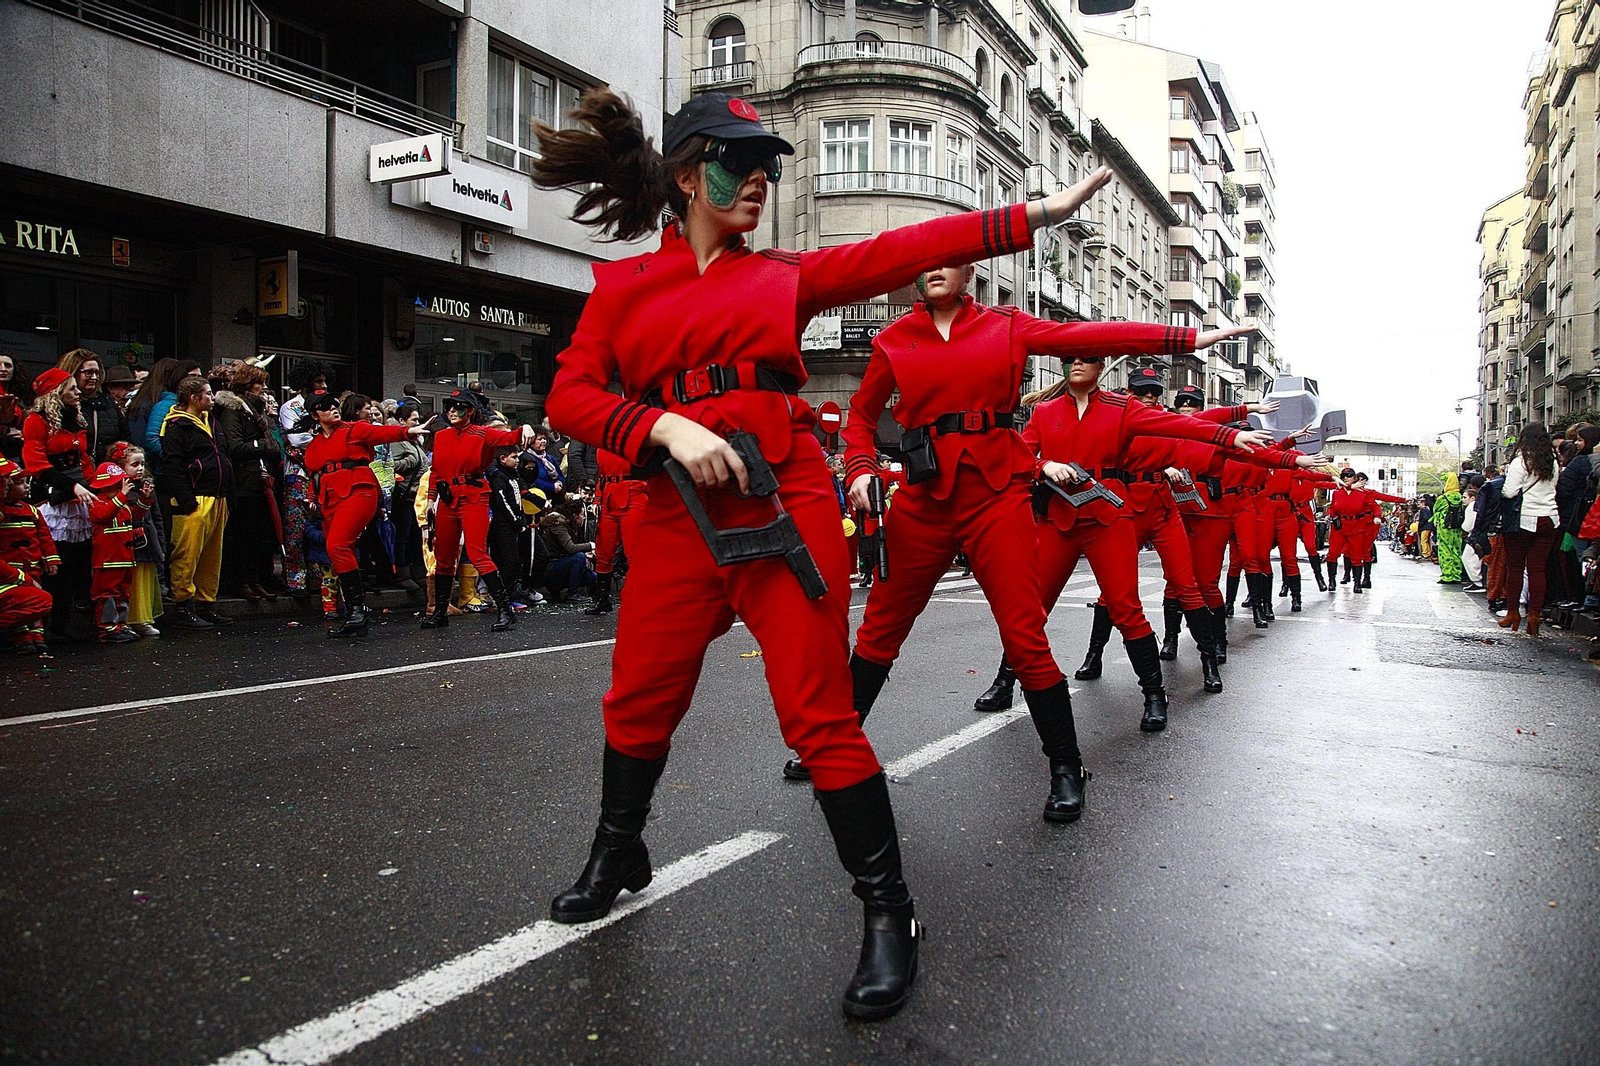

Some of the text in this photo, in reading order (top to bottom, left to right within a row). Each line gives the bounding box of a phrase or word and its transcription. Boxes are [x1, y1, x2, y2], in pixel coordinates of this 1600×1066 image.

[378, 151, 419, 169] helvetia
[452, 178, 499, 205] helvetia
[15, 220, 81, 256] RITA
[430, 296, 471, 318] AUTOS
[480, 304, 516, 326] SANTA
